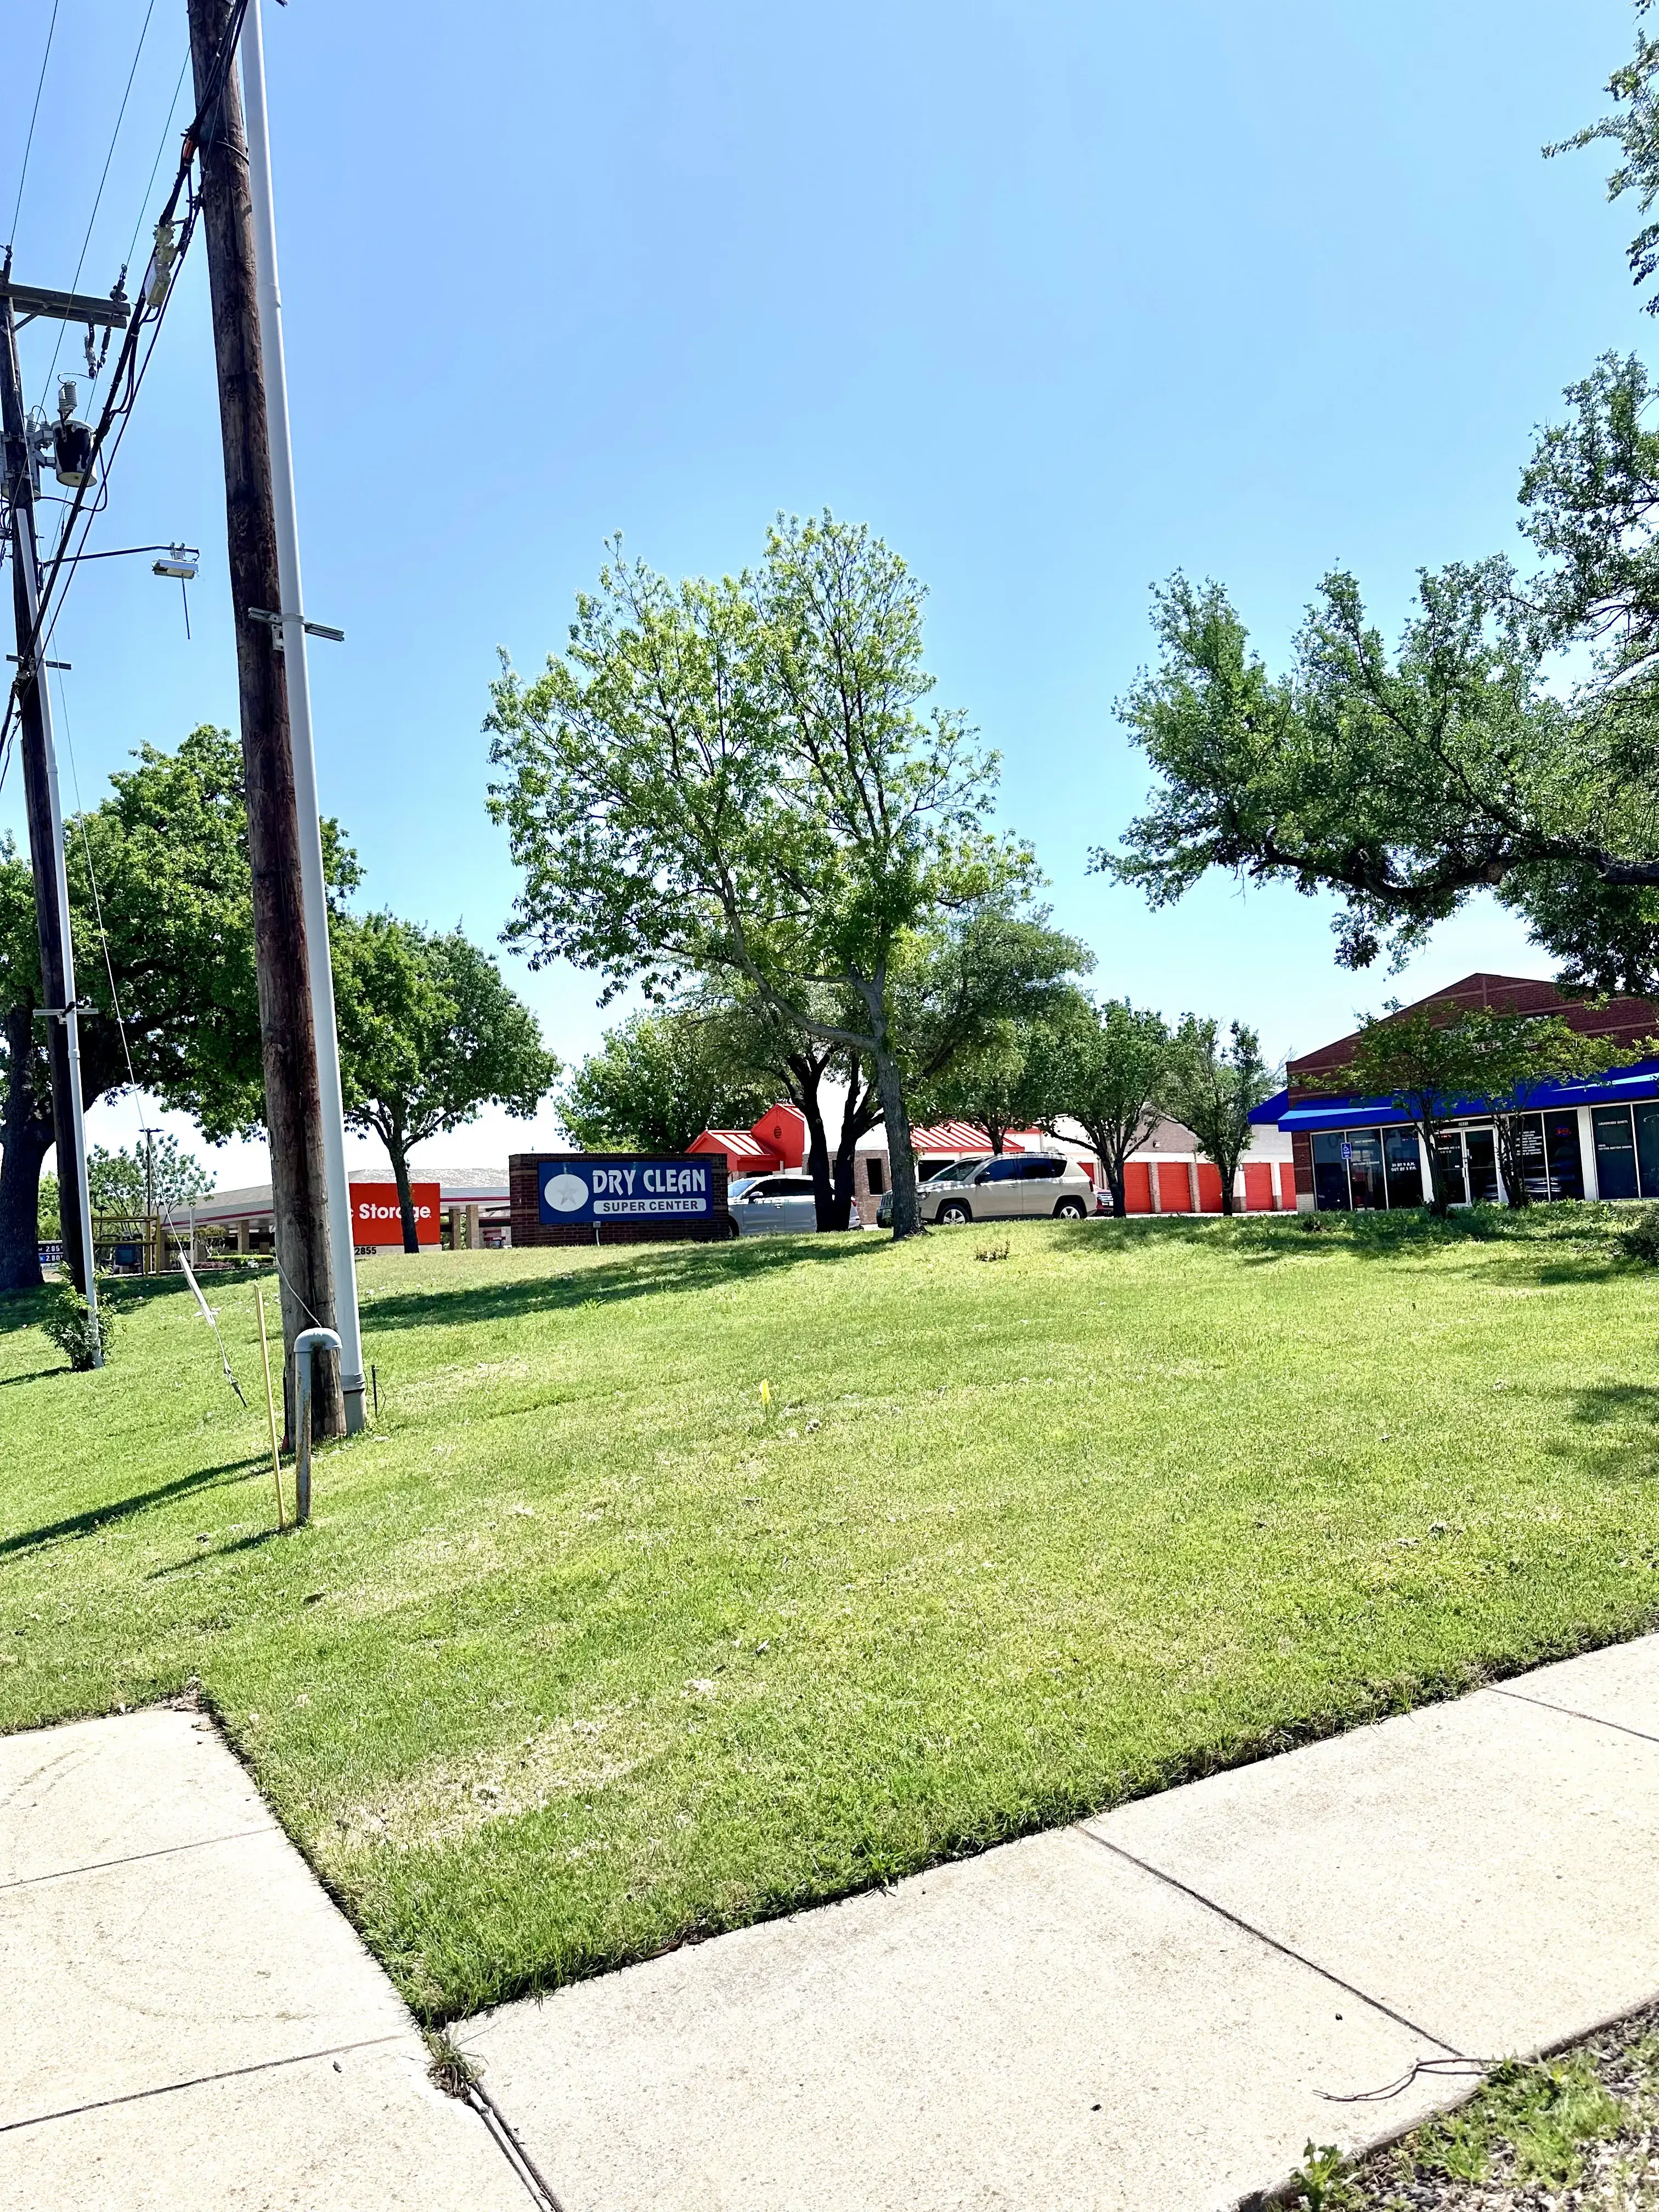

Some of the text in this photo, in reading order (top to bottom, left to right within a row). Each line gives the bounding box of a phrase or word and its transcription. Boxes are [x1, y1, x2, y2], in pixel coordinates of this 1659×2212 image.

[592, 1169, 706, 1196] DRY CLEAN
[603, 1200, 698, 1212] SUPER CENTER
[354, 1246, 377, 1255] 2855
